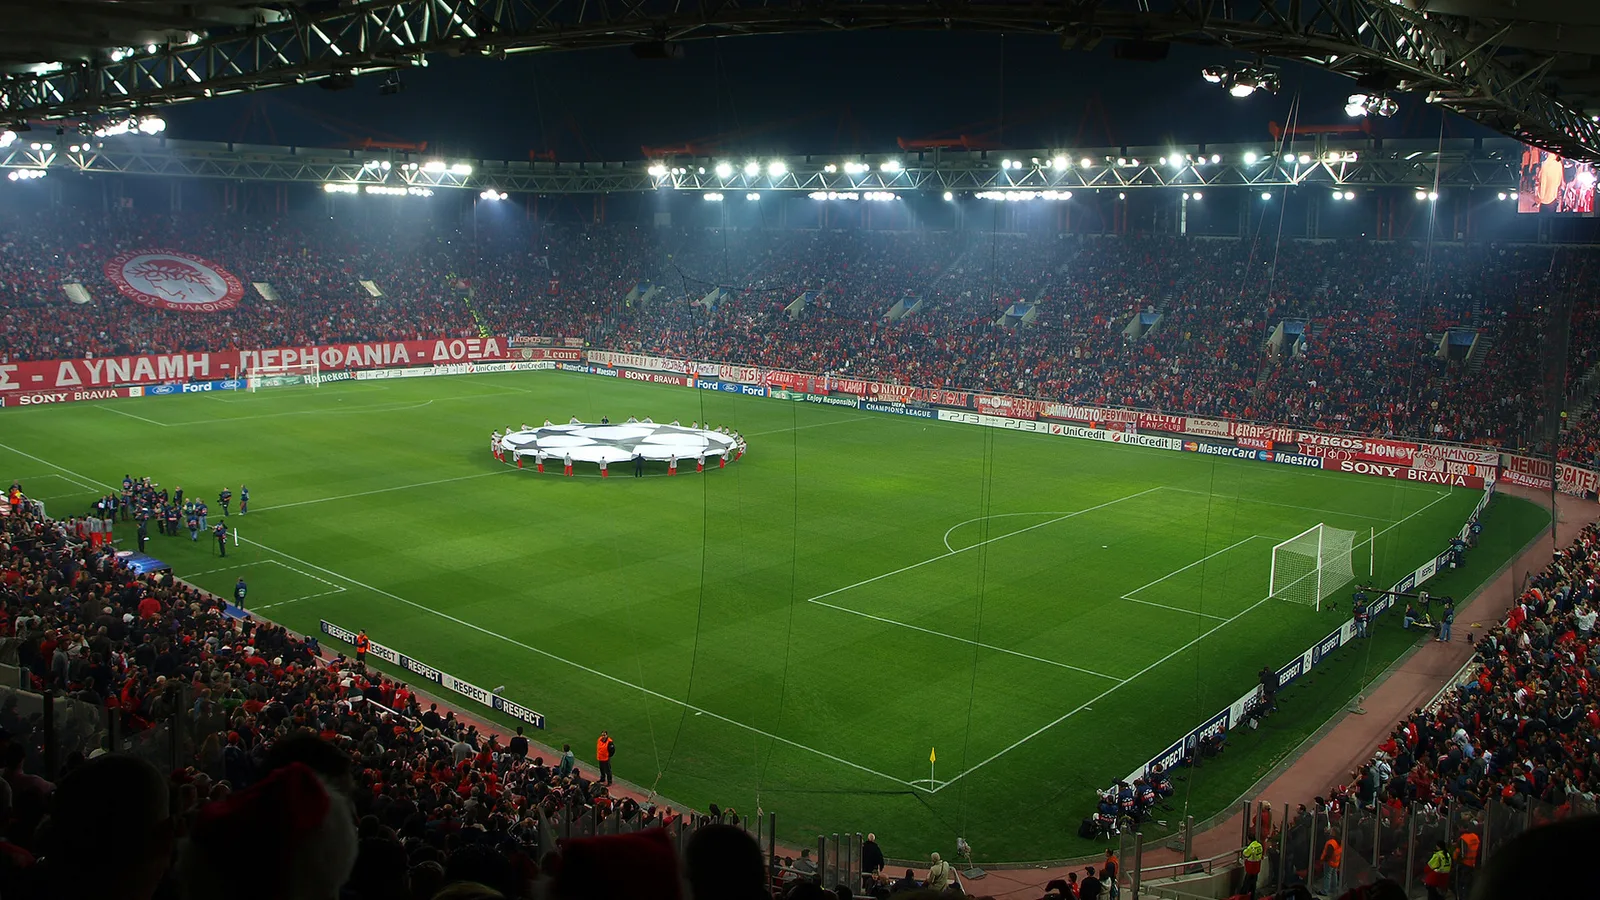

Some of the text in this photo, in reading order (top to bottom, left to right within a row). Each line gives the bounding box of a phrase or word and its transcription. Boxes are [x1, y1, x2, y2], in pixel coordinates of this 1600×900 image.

[55, 353, 209, 386] ΔΥΝΑΜΗ
[240, 343, 410, 373] ΠΕΡΗΦΑΝΙΑ
[432, 338, 500, 361] ΔΟΞΑ
[476, 361, 546, 372] UniCredit UniCredit
[304, 371, 349, 384] Heineken
[625, 371, 680, 385] SONY BRAVIA
[182, 382, 212, 392] Ford
[698, 380, 718, 390] Ford
[742, 386, 764, 396] Ford
[20, 392, 68, 405] SONY
[74, 390, 118, 400] BRAVIA
[807, 394, 822, 404] Enjoy
[822, 396, 857, 408] Responsibly
[866, 403, 931, 417] CHAMPIONS LEAGUE
[1049, 403, 1104, 421] ΑΜΜΟΧΩΣΤΟ
[949, 413, 979, 423] PS3
[1005, 419, 1036, 430] PS3
[1063, 426, 1168, 448] UniCredit UniCredit
[1298, 432, 1363, 449] PYRGOS
[1199, 443, 1319, 467] MasterCard Maestro
[1341, 460, 1399, 477] SONY
[1408, 469, 1466, 486] BRAVIA
[328, 625, 541, 726] RESPECT ESPECT RESPECT RESPECT RESPECT
[1279, 662, 1300, 686] RESPECT
